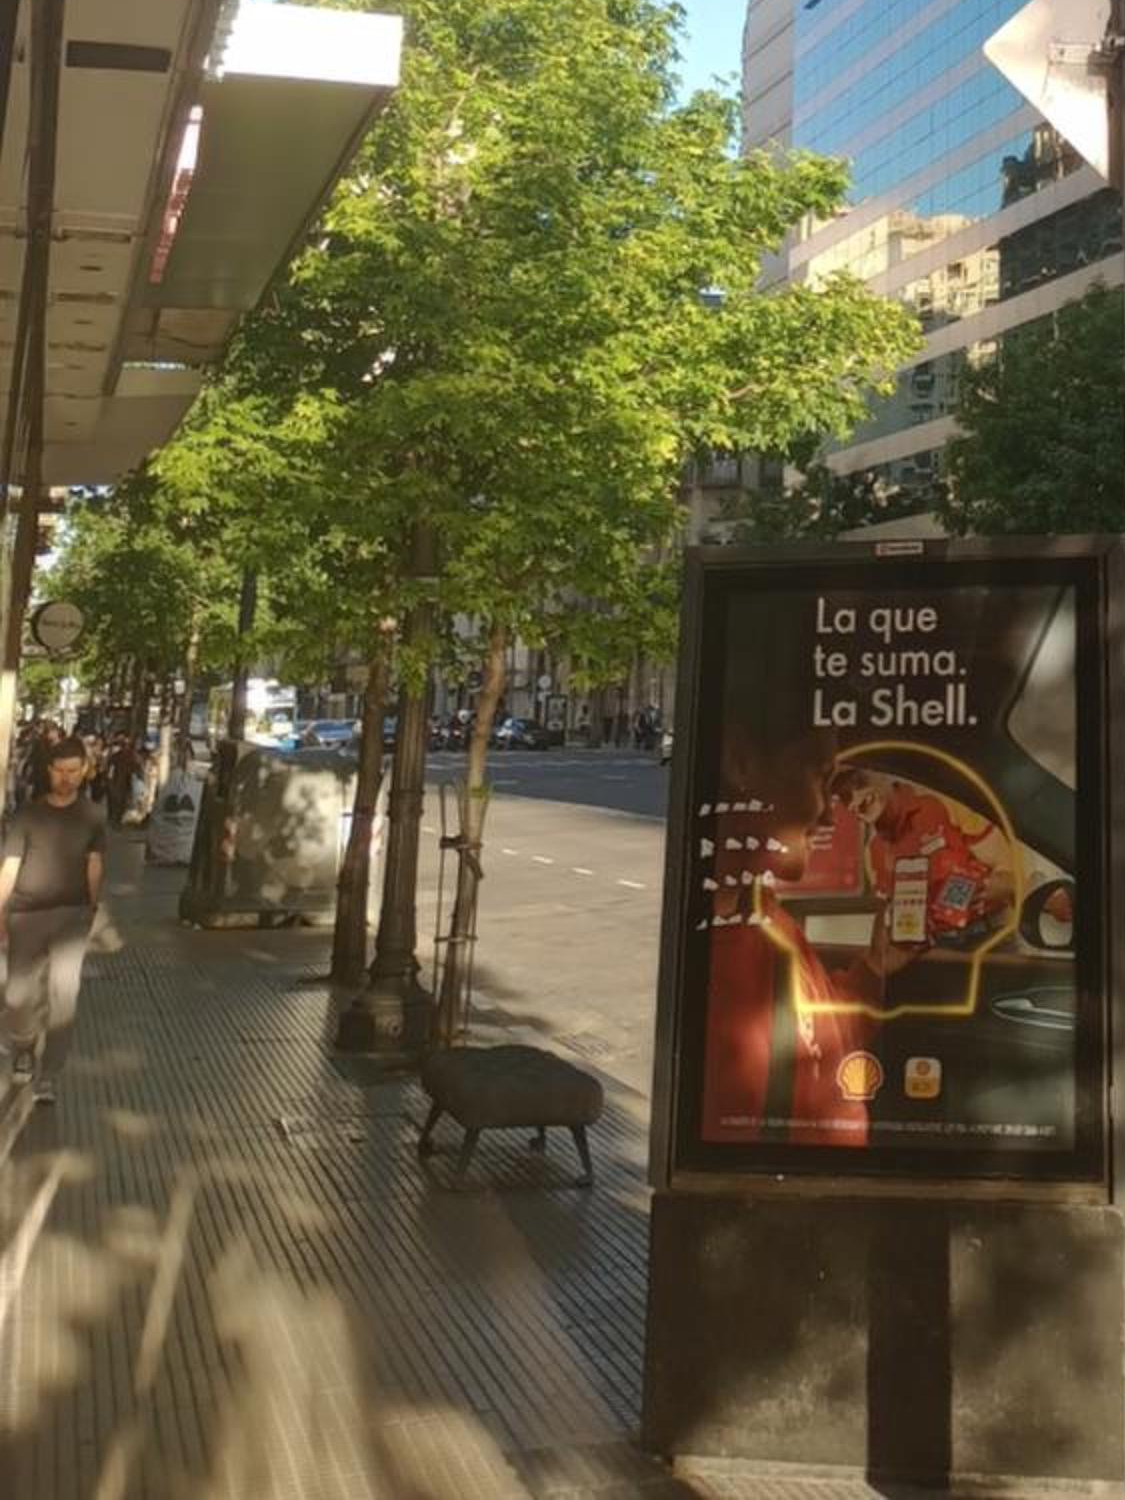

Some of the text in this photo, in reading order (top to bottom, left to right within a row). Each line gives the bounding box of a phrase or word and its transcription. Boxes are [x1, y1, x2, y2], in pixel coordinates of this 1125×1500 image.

[816, 596, 938, 644] La que
[813, 644, 967, 678] te suma.
[813, 682, 978, 728] La Shell.
